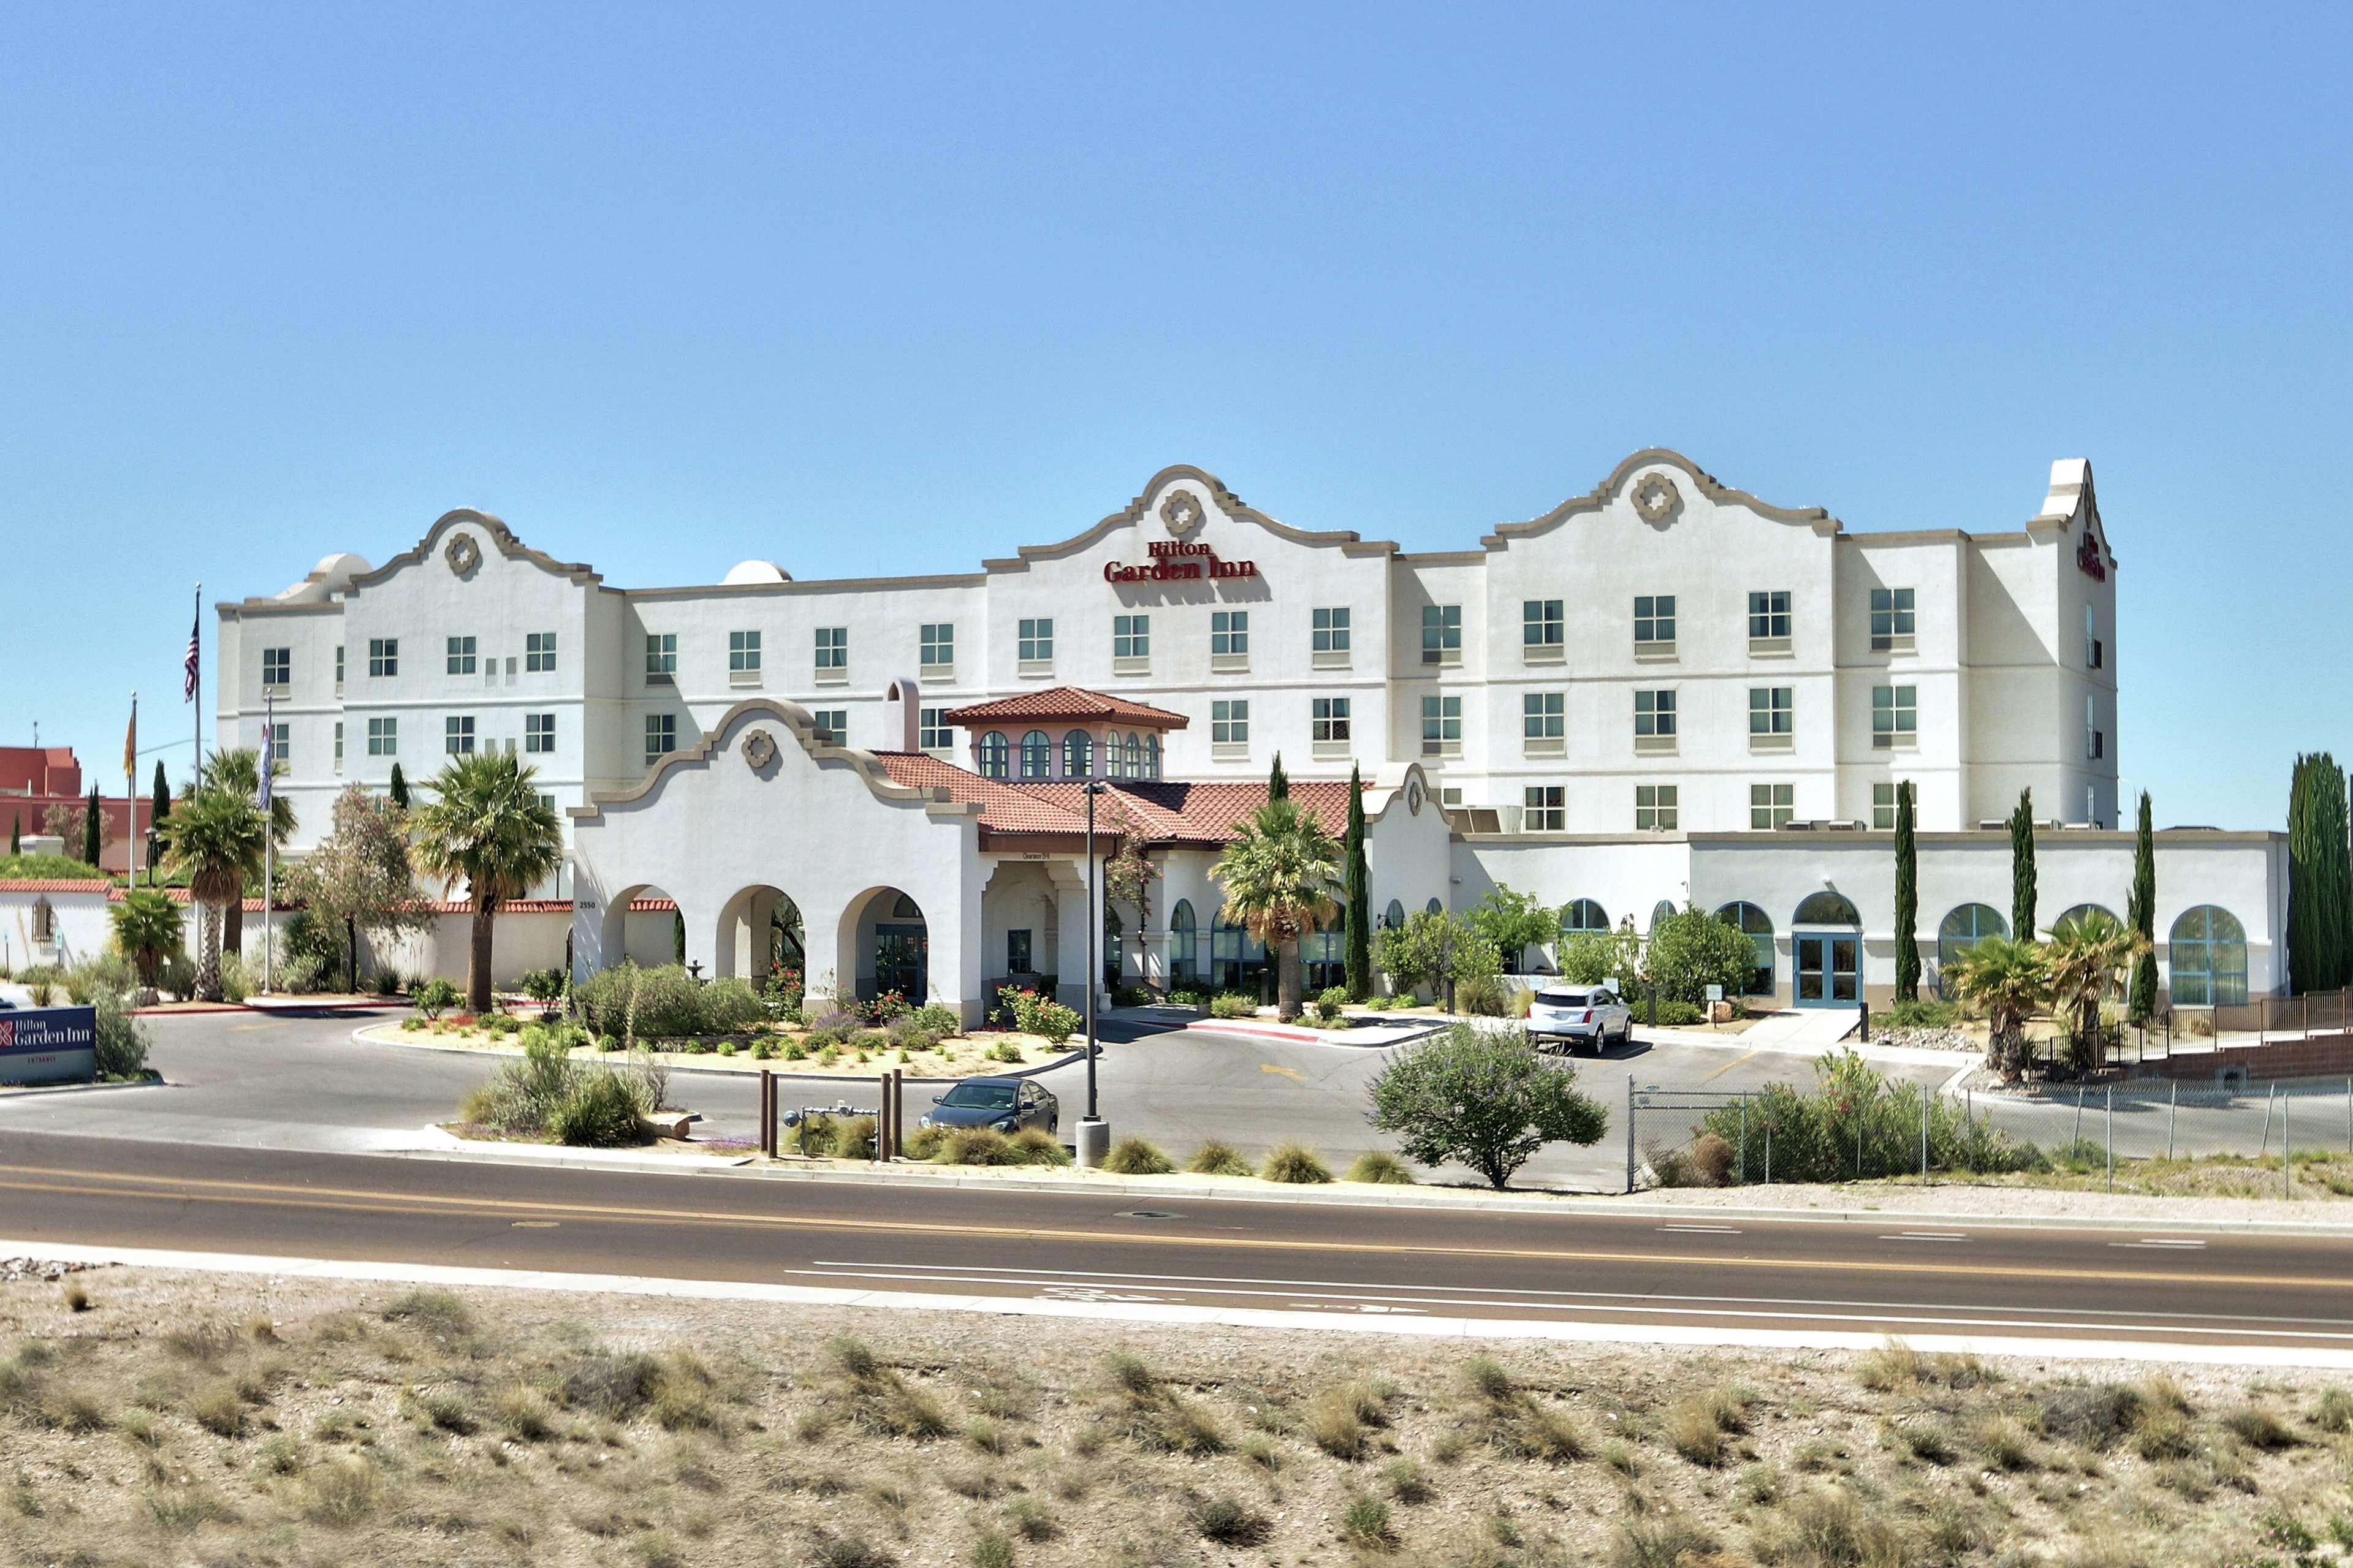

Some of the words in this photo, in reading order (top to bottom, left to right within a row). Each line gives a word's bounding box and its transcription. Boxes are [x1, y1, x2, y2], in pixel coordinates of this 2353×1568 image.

[1148, 540, 1211, 557] Hilton
[1104, 558, 1201, 582] Garden
[1208, 556, 1256, 578] Inn
[15, 1019, 47, 1031] Hilton
[14, 1029, 64, 1046] Garden
[67, 1027, 91, 1042] Inn
